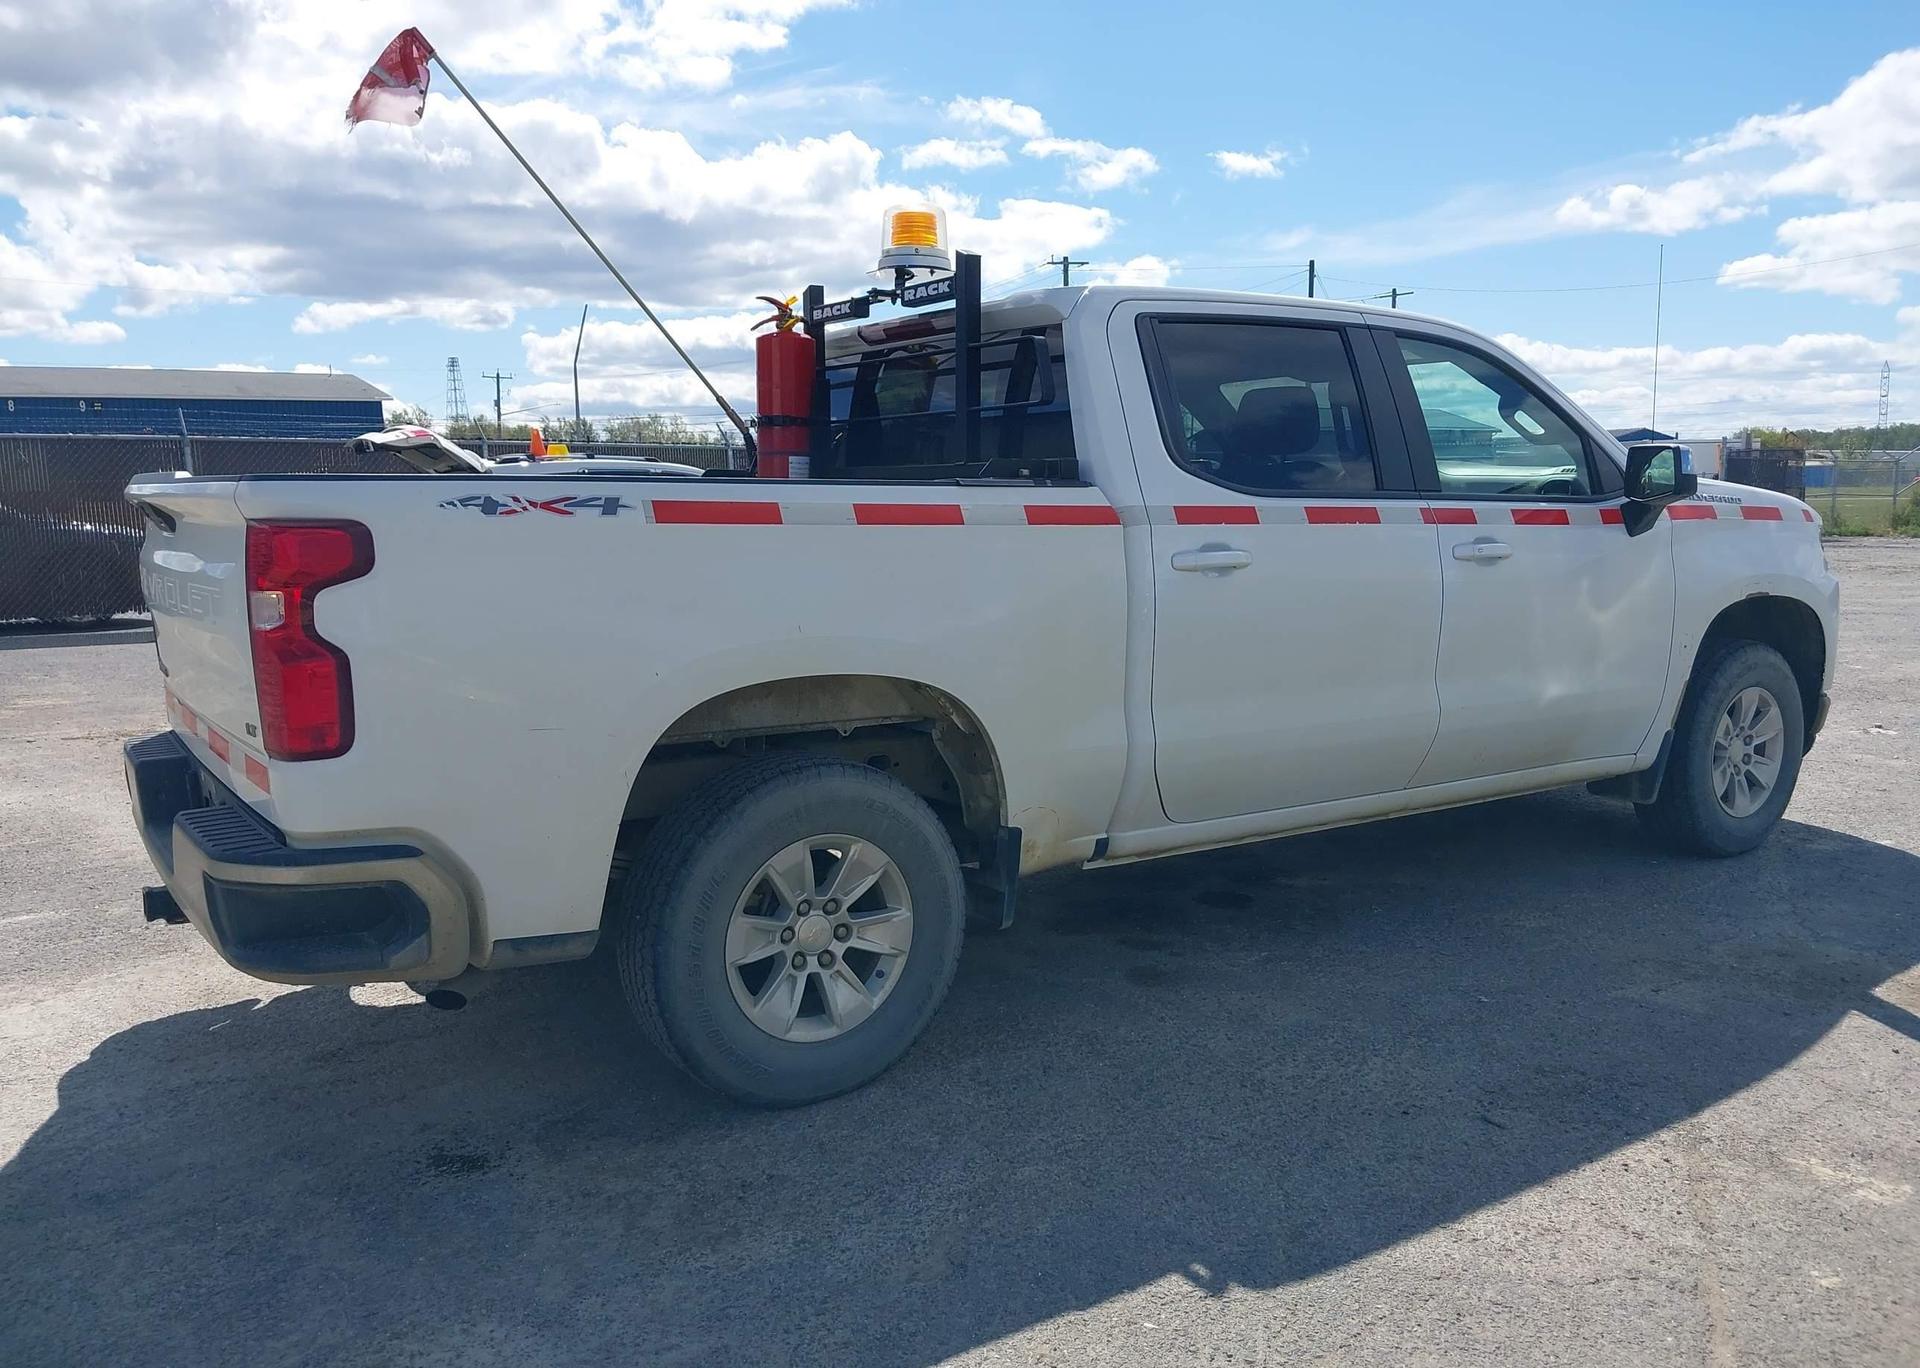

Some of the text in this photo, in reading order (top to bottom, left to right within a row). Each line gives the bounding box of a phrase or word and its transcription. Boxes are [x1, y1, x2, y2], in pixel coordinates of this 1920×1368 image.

[812, 281, 950, 320] BACK RACK
[7, 400, 15, 411] 8
[79, 400, 86, 412] 9
